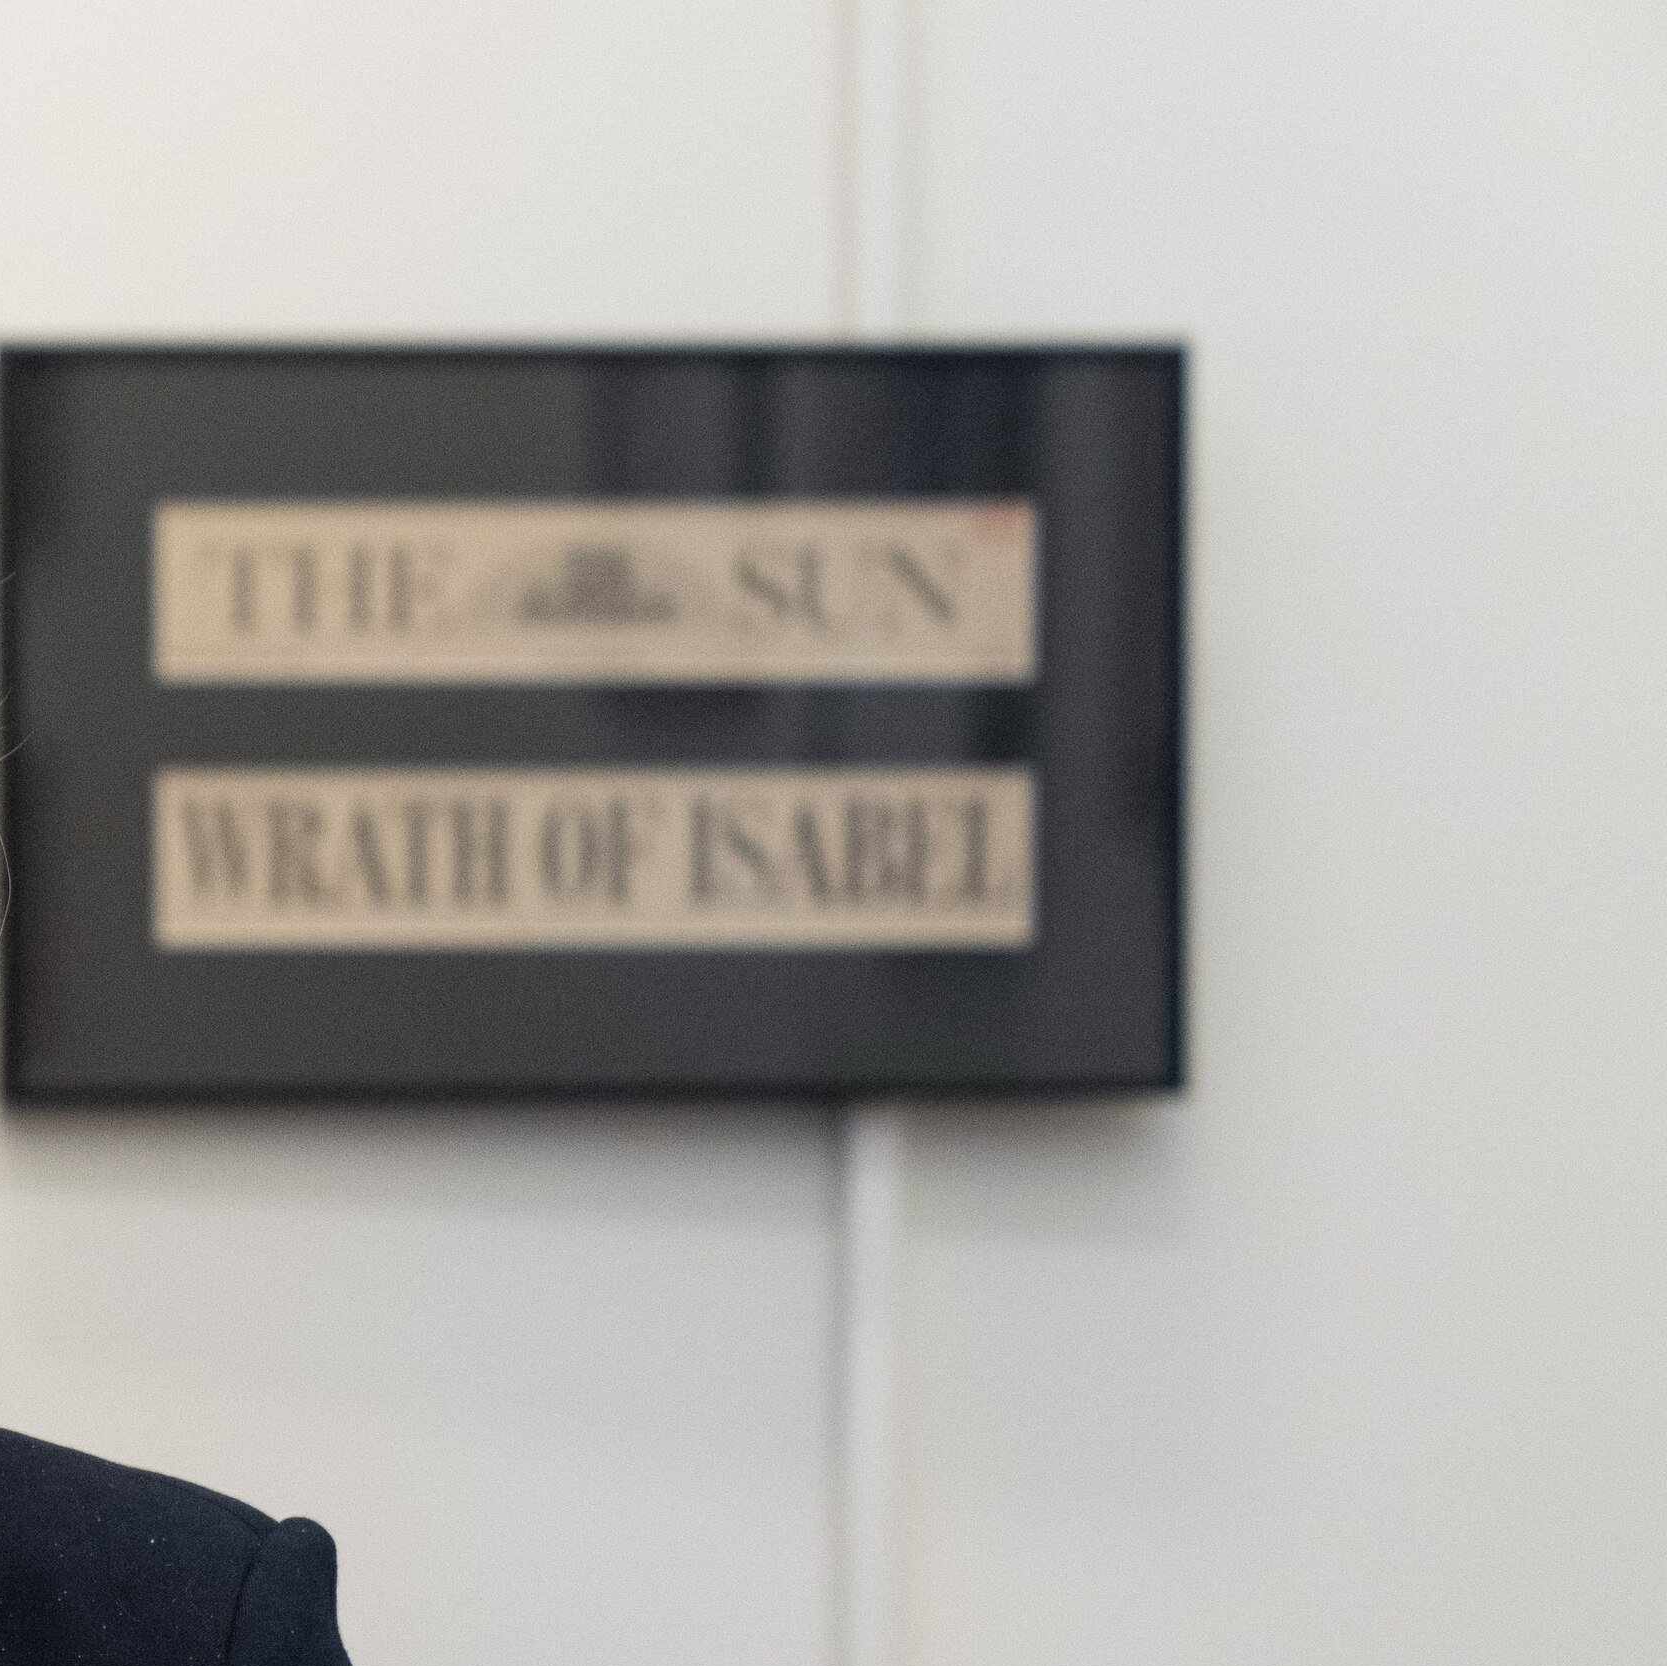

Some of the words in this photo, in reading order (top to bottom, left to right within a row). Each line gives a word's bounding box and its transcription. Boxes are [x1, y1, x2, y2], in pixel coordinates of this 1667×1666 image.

[197, 536, 461, 640] THE
[727, 536, 973, 640] SUN
[173, 796, 513, 908] WRATH
[537, 796, 651, 908] OF
[684, 796, 1007, 908] ISABEL
